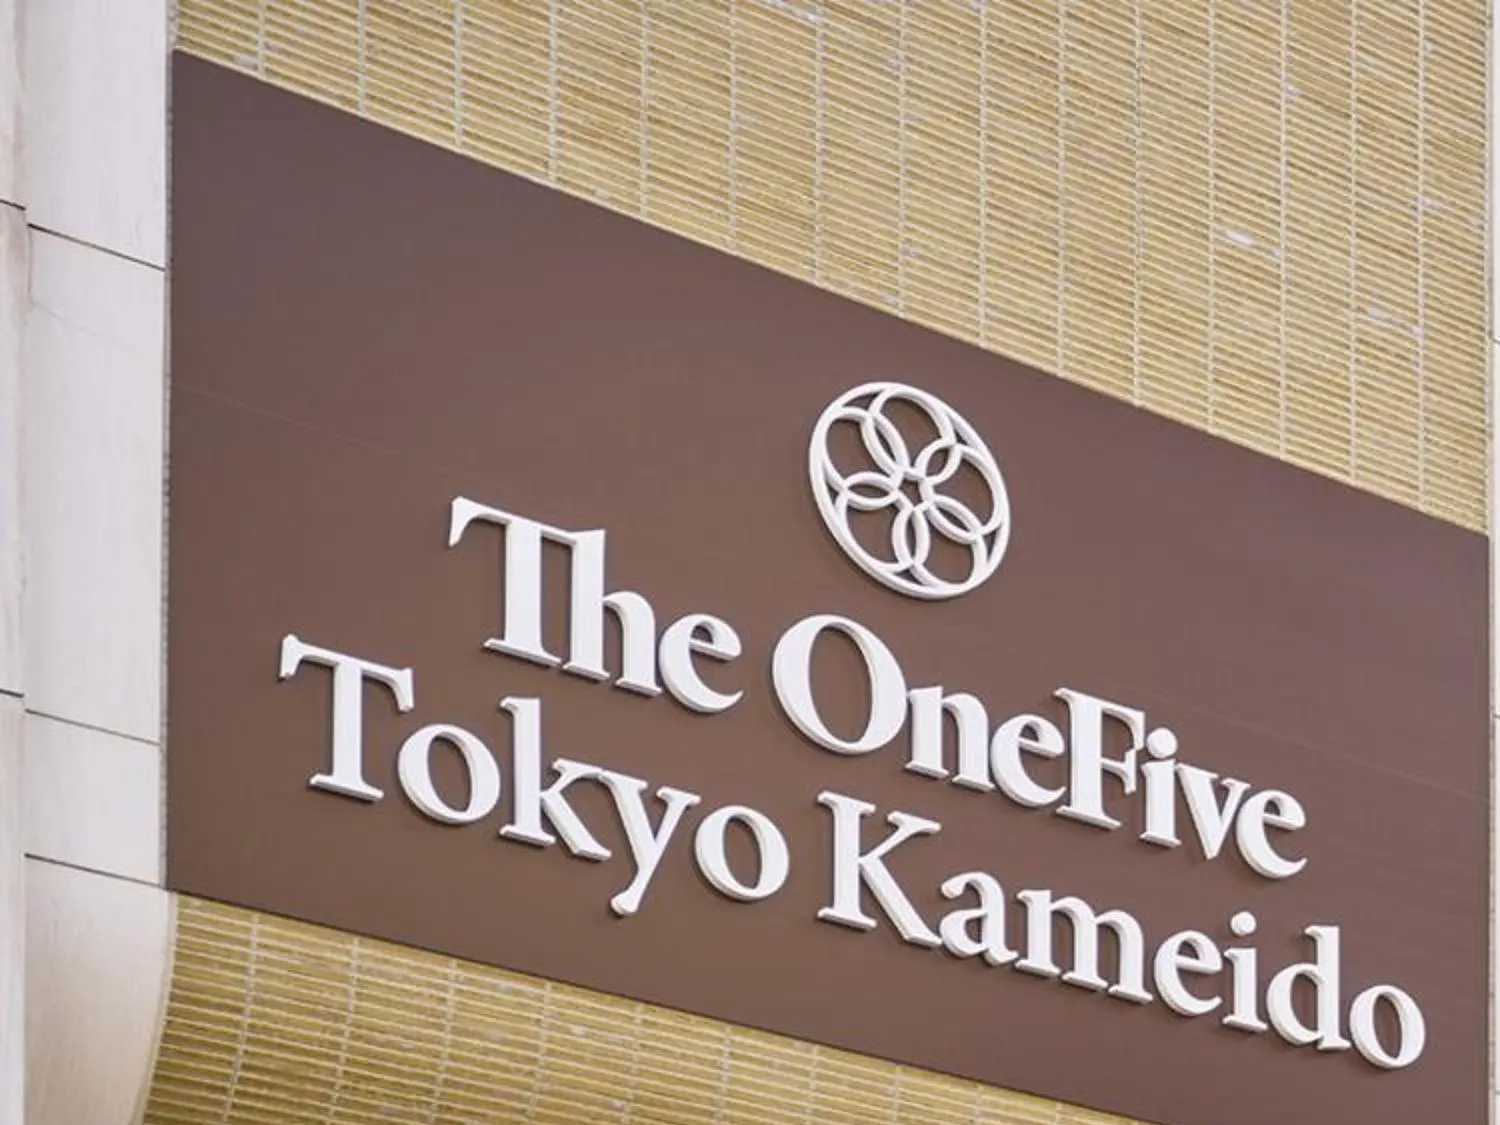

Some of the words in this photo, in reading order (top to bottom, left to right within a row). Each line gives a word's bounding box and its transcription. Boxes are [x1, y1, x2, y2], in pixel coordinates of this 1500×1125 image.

[280, 634, 789, 915] Tokyo
[818, 791, 1425, 1068] Kameido
[449, 496, 743, 710] The
[773, 615, 1307, 877] OneFive
